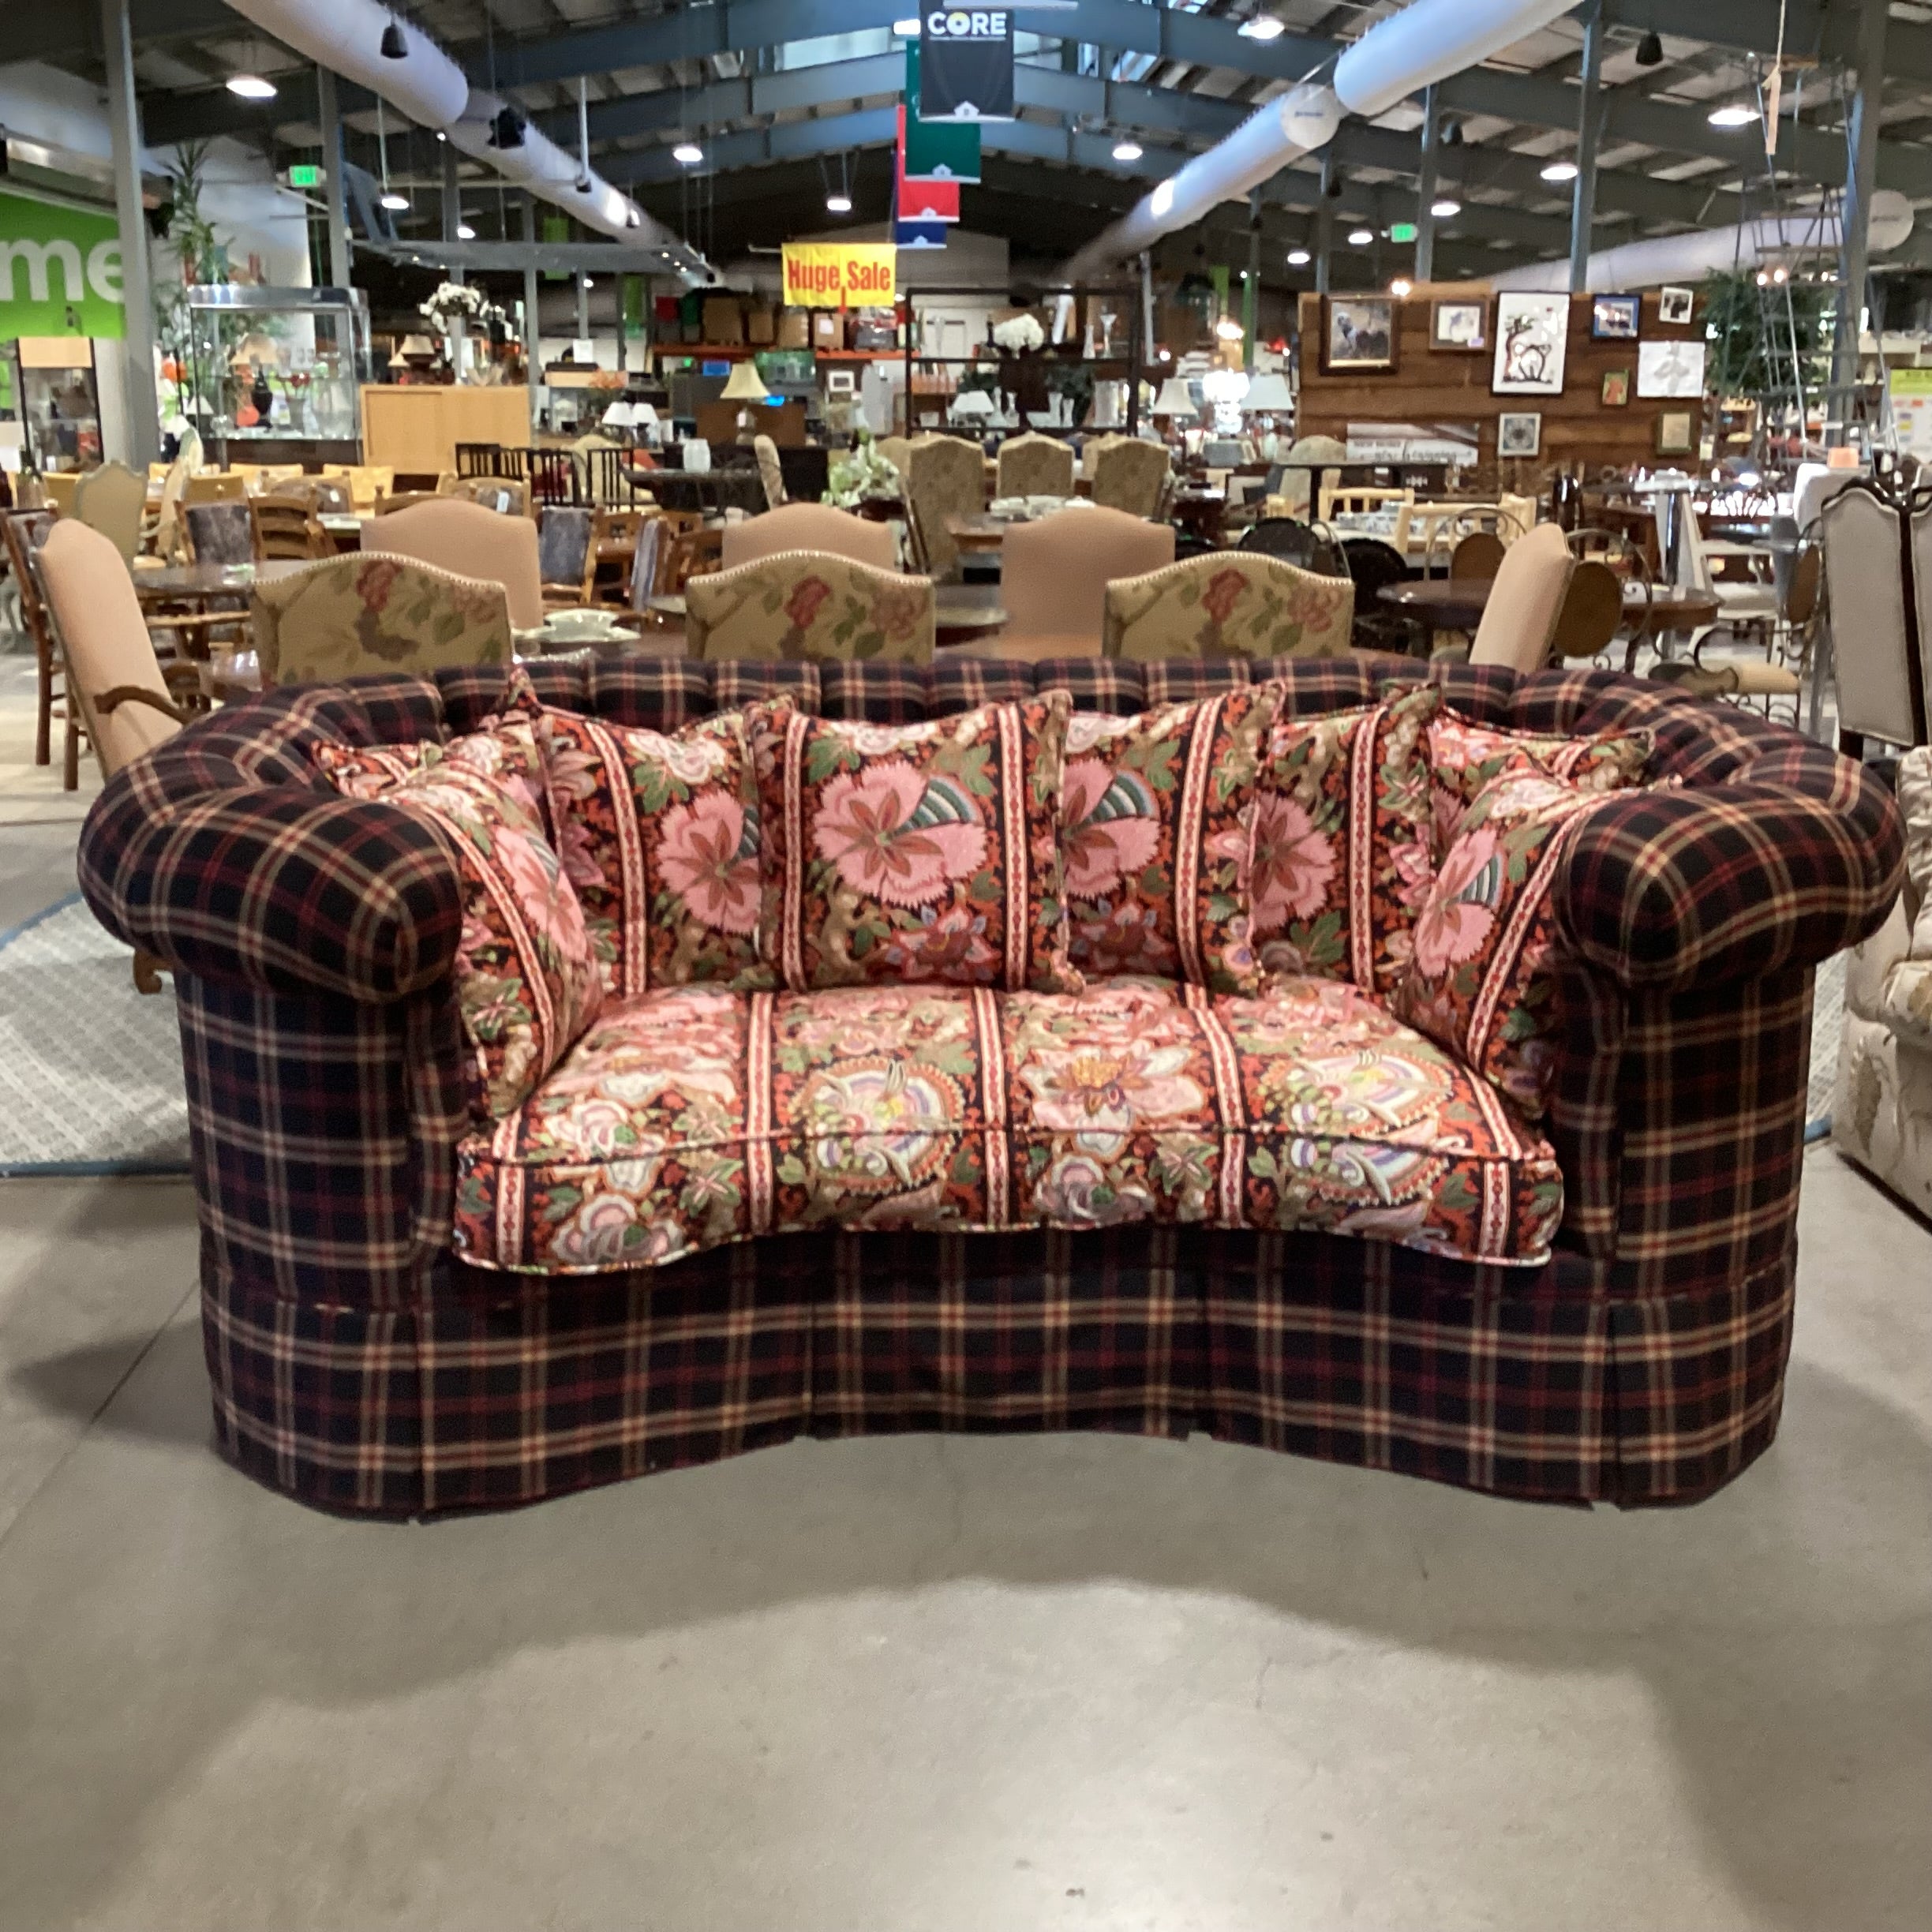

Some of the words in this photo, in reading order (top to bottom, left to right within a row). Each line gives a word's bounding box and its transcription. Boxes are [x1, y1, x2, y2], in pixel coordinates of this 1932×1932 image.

[927, 11, 1007, 36] CORE
[788, 259, 840, 293] Huge
[847, 260, 891, 290] Sale
